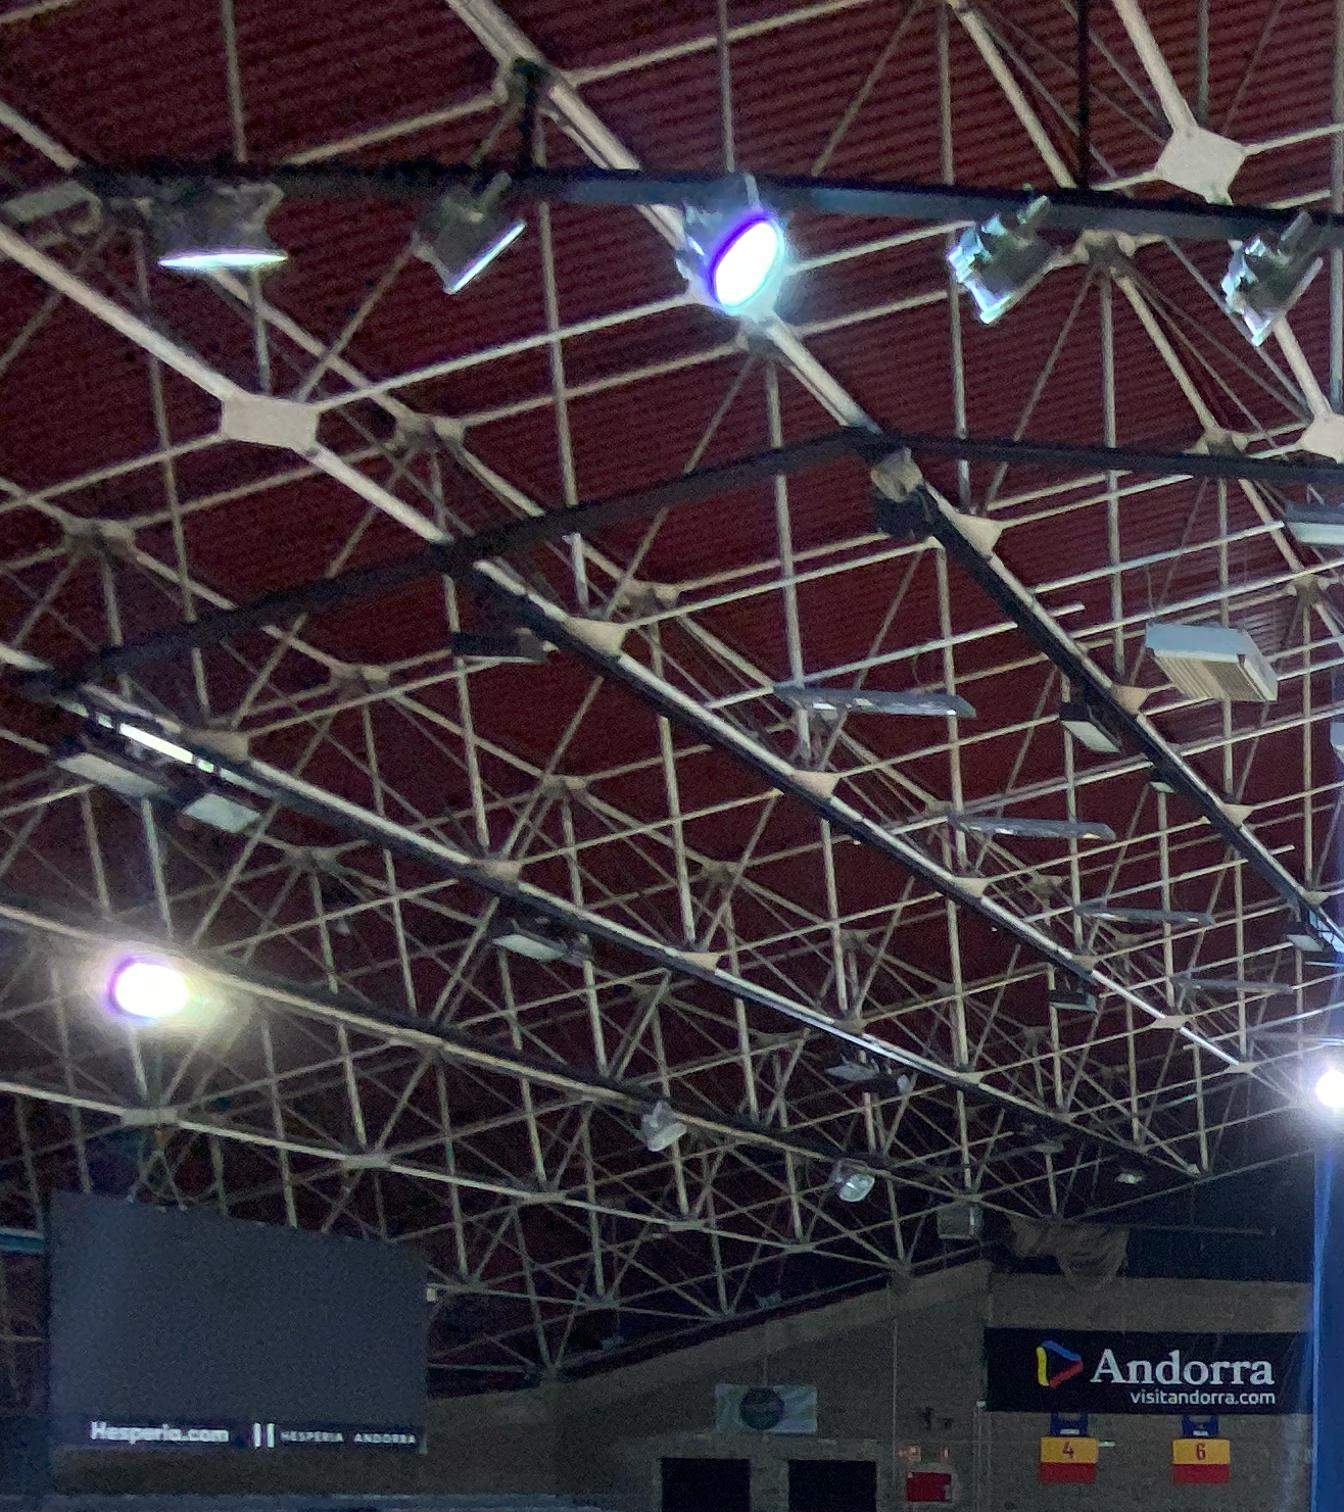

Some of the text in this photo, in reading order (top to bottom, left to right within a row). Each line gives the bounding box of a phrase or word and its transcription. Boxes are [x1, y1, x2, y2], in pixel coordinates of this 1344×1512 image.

[1090, 1348, 1275, 1386] Andorra
[1130, 1388, 1276, 1405] visitandorra.com
[1062, 1441, 1074, 1459] 4
[1195, 1442, 1207, 1460] 6
